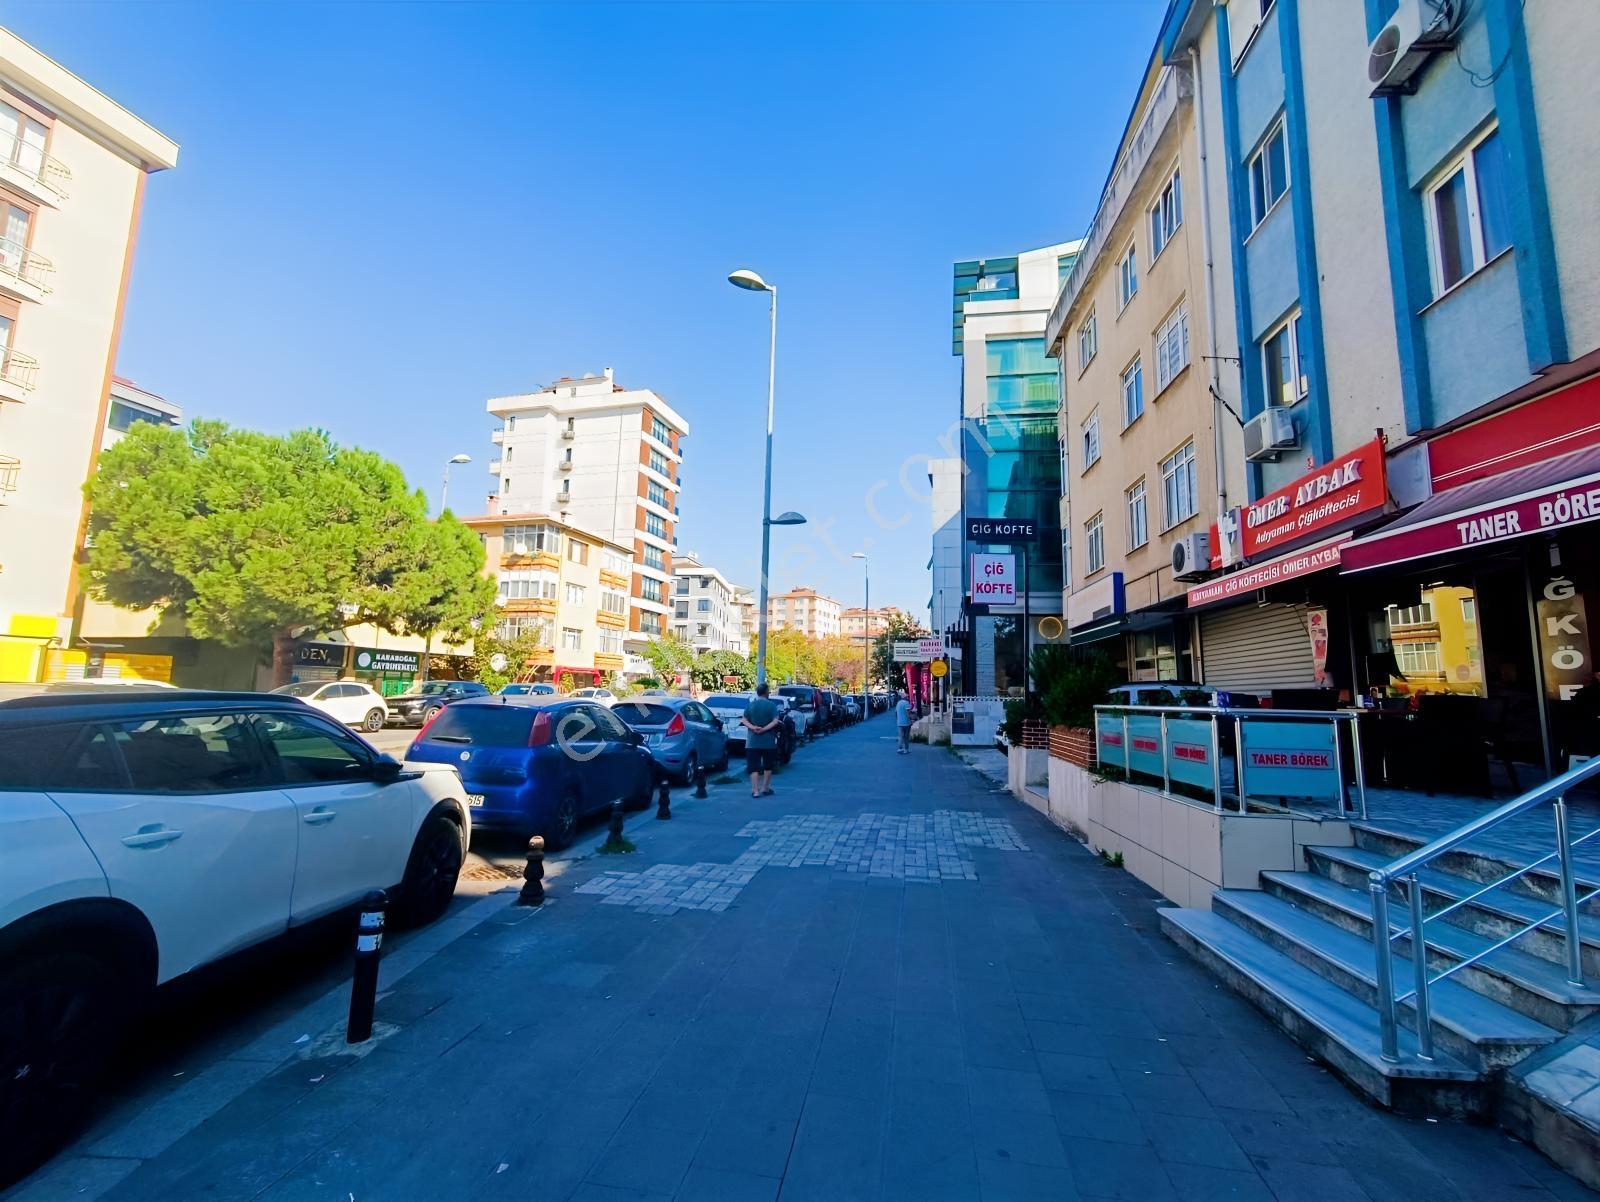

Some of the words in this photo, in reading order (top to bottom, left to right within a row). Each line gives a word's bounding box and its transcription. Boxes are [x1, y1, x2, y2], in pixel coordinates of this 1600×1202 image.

[1247, 496, 1289, 529] ÖMER
[1294, 459, 1363, 508] AYBAK
[1457, 510, 1521, 544] TANER
[1539, 489, 1600, 527] BÖRE
[984, 562, 1004, 577] ÇİĞ
[1283, 557, 1310, 575] ÖMER
[1311, 547, 1341, 567] AYBA
[976, 581, 1013, 594] KÖFTE
[1251, 753, 1288, 766] TANER
[1291, 752, 1329, 767] BÖREK
